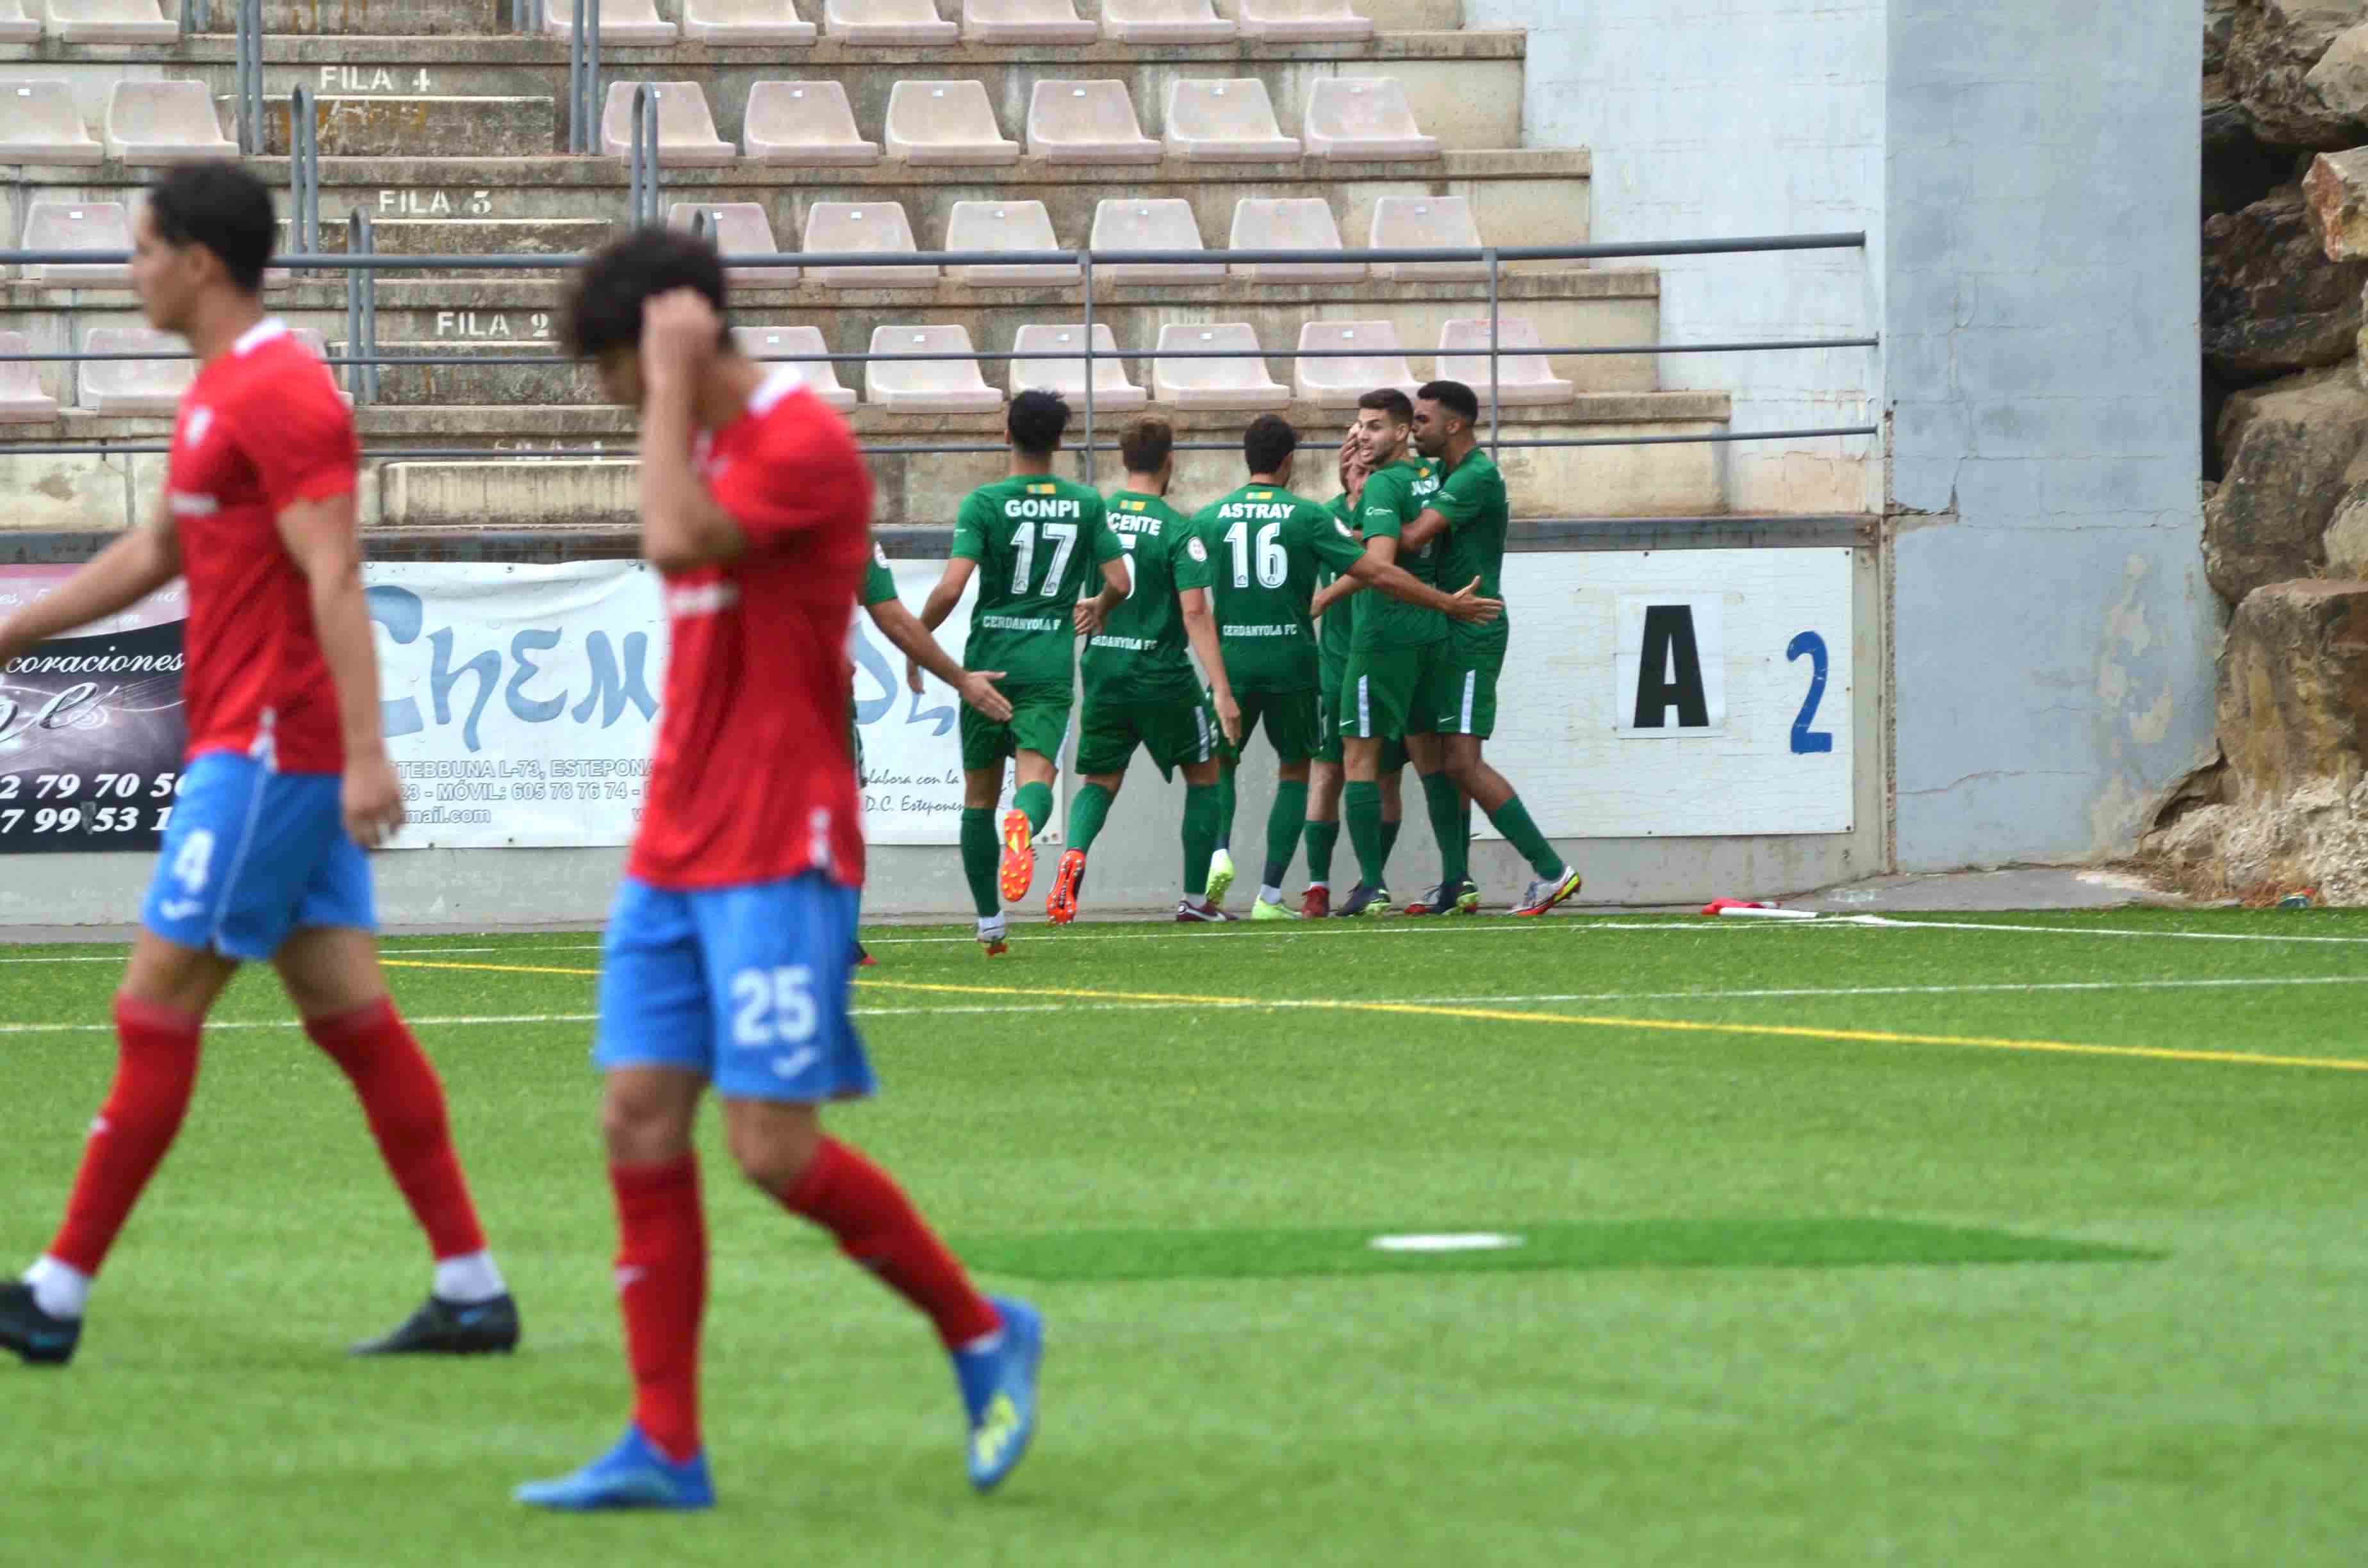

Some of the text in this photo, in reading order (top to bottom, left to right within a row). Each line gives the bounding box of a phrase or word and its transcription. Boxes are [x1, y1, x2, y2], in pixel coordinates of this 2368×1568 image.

[321, 66, 431, 92] FILA 4
[379, 190, 450, 214] FILA
[436, 312, 549, 337] FILA 2
[1004, 500, 1080, 518] GONPI
[1217, 503, 1295, 519] ASTRAY
[1010, 521, 1078, 597] 17
[1223, 522, 1288, 588] 16
[1222, 624, 1297, 636] CERDANYOLA FC
[1633, 605, 1709, 728] A
[1786, 630, 1832, 754] 2
[499, 760, 545, 780] L-73,
[916, 776, 941, 785] con
[36, 774, 81, 799] 79
[95, 773, 140, 797] 70
[436, 780, 507, 801] MÓVIL:
[512, 782, 546, 801] 605
[549, 781, 574, 800] 78
[577, 781, 601, 800] 76
[604, 781, 628, 799] 74
[33, 808, 81, 833] 99
[92, 806, 140, 832] 53
[730, 967, 818, 1046] 25
